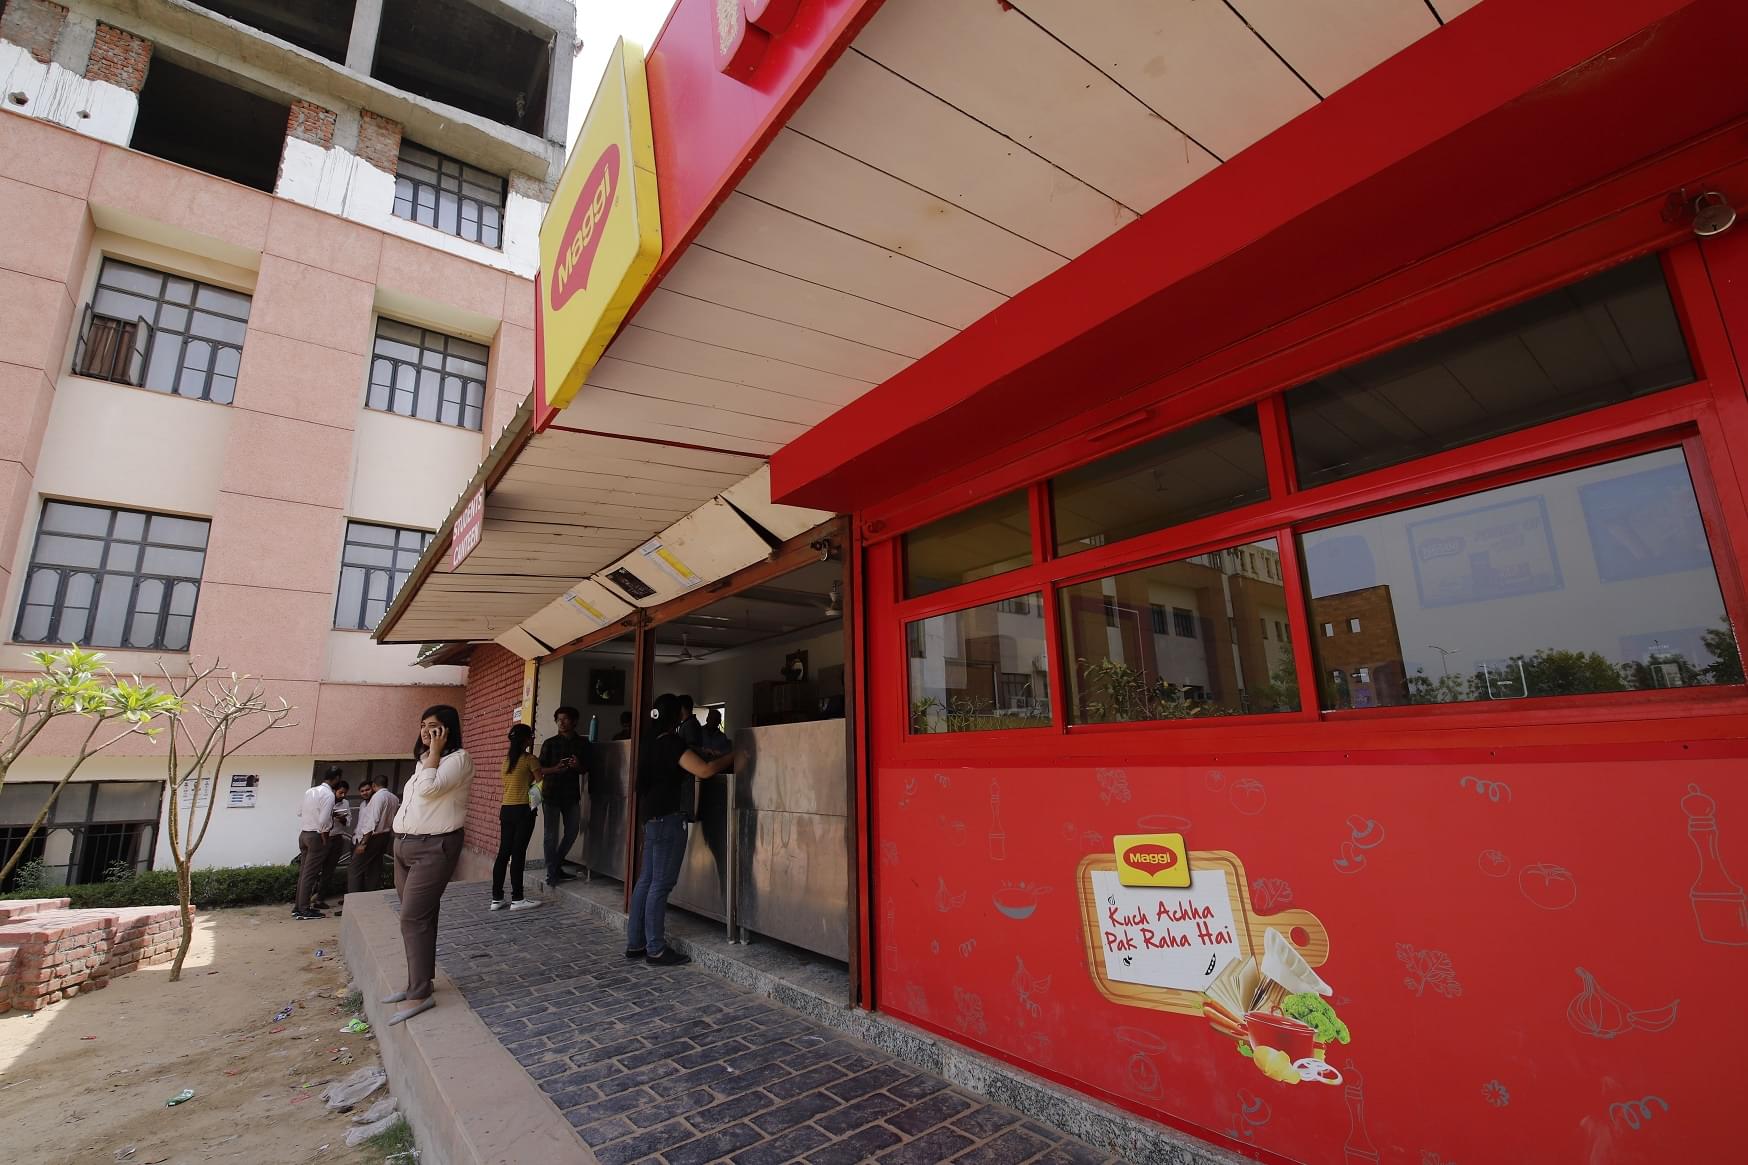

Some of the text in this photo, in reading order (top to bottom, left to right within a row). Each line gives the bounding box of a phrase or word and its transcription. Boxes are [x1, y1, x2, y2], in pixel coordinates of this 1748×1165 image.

[558, 163, 611, 295] Maggi
[453, 489, 483, 540] STUDENTS
[453, 522, 481, 566] CANTEEN
[1129, 851, 1171, 864] Maggi
[1108, 899, 1215, 927] Kuch Achha
[1104, 921, 1233, 952] Pak Raha Hai
